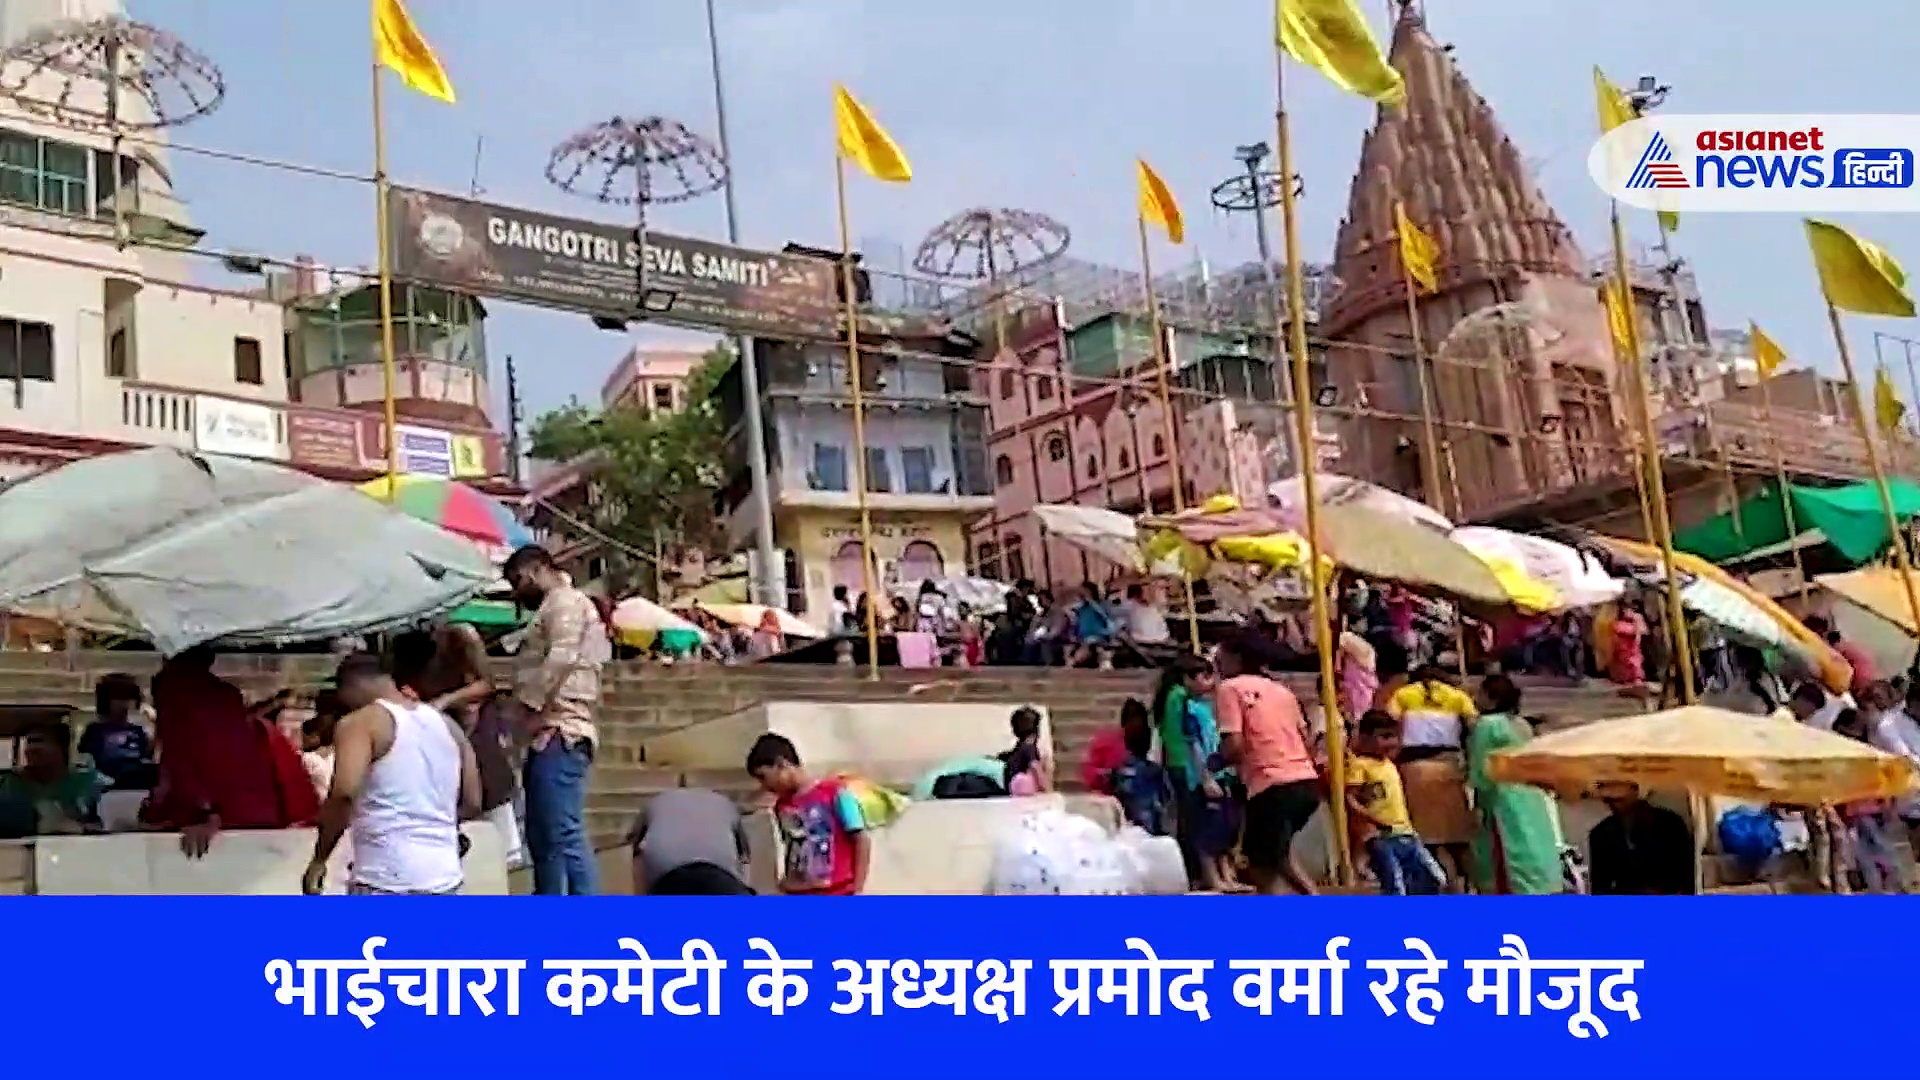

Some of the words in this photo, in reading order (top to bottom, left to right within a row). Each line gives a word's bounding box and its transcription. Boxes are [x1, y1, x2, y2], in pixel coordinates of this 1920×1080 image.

[487, 216, 619, 265] GANGOTRI
[624, 241, 687, 275] SEVA
[691, 251, 769, 288] SAMITI
